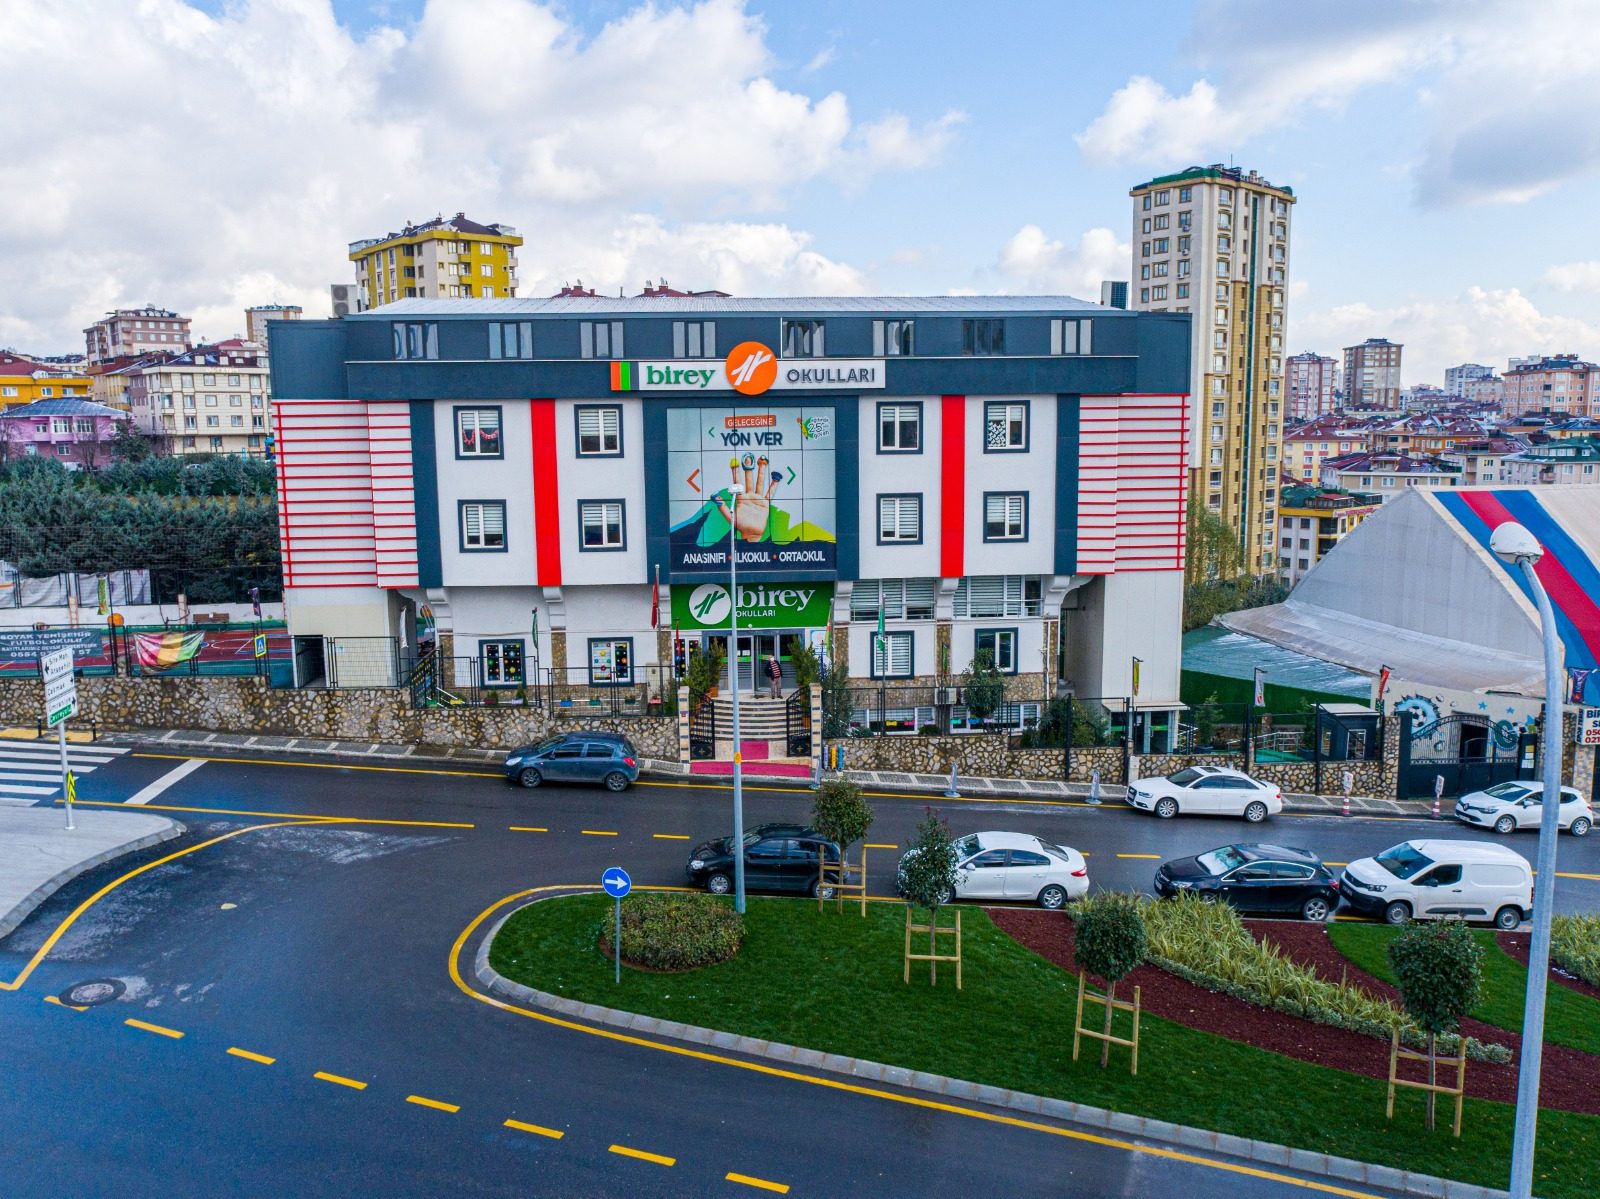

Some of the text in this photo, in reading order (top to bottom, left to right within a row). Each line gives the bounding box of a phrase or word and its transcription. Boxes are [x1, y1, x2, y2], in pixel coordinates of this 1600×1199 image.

[646, 365, 875, 388] birey OKULLARI
[727, 417, 773, 427] GELECEĞİNE
[720, 429, 783, 446] YÖN VER
[683, 550, 826, 564] ANASINIFI İLKOKUL ORTAOKUL
[735, 585, 816, 612] birey
